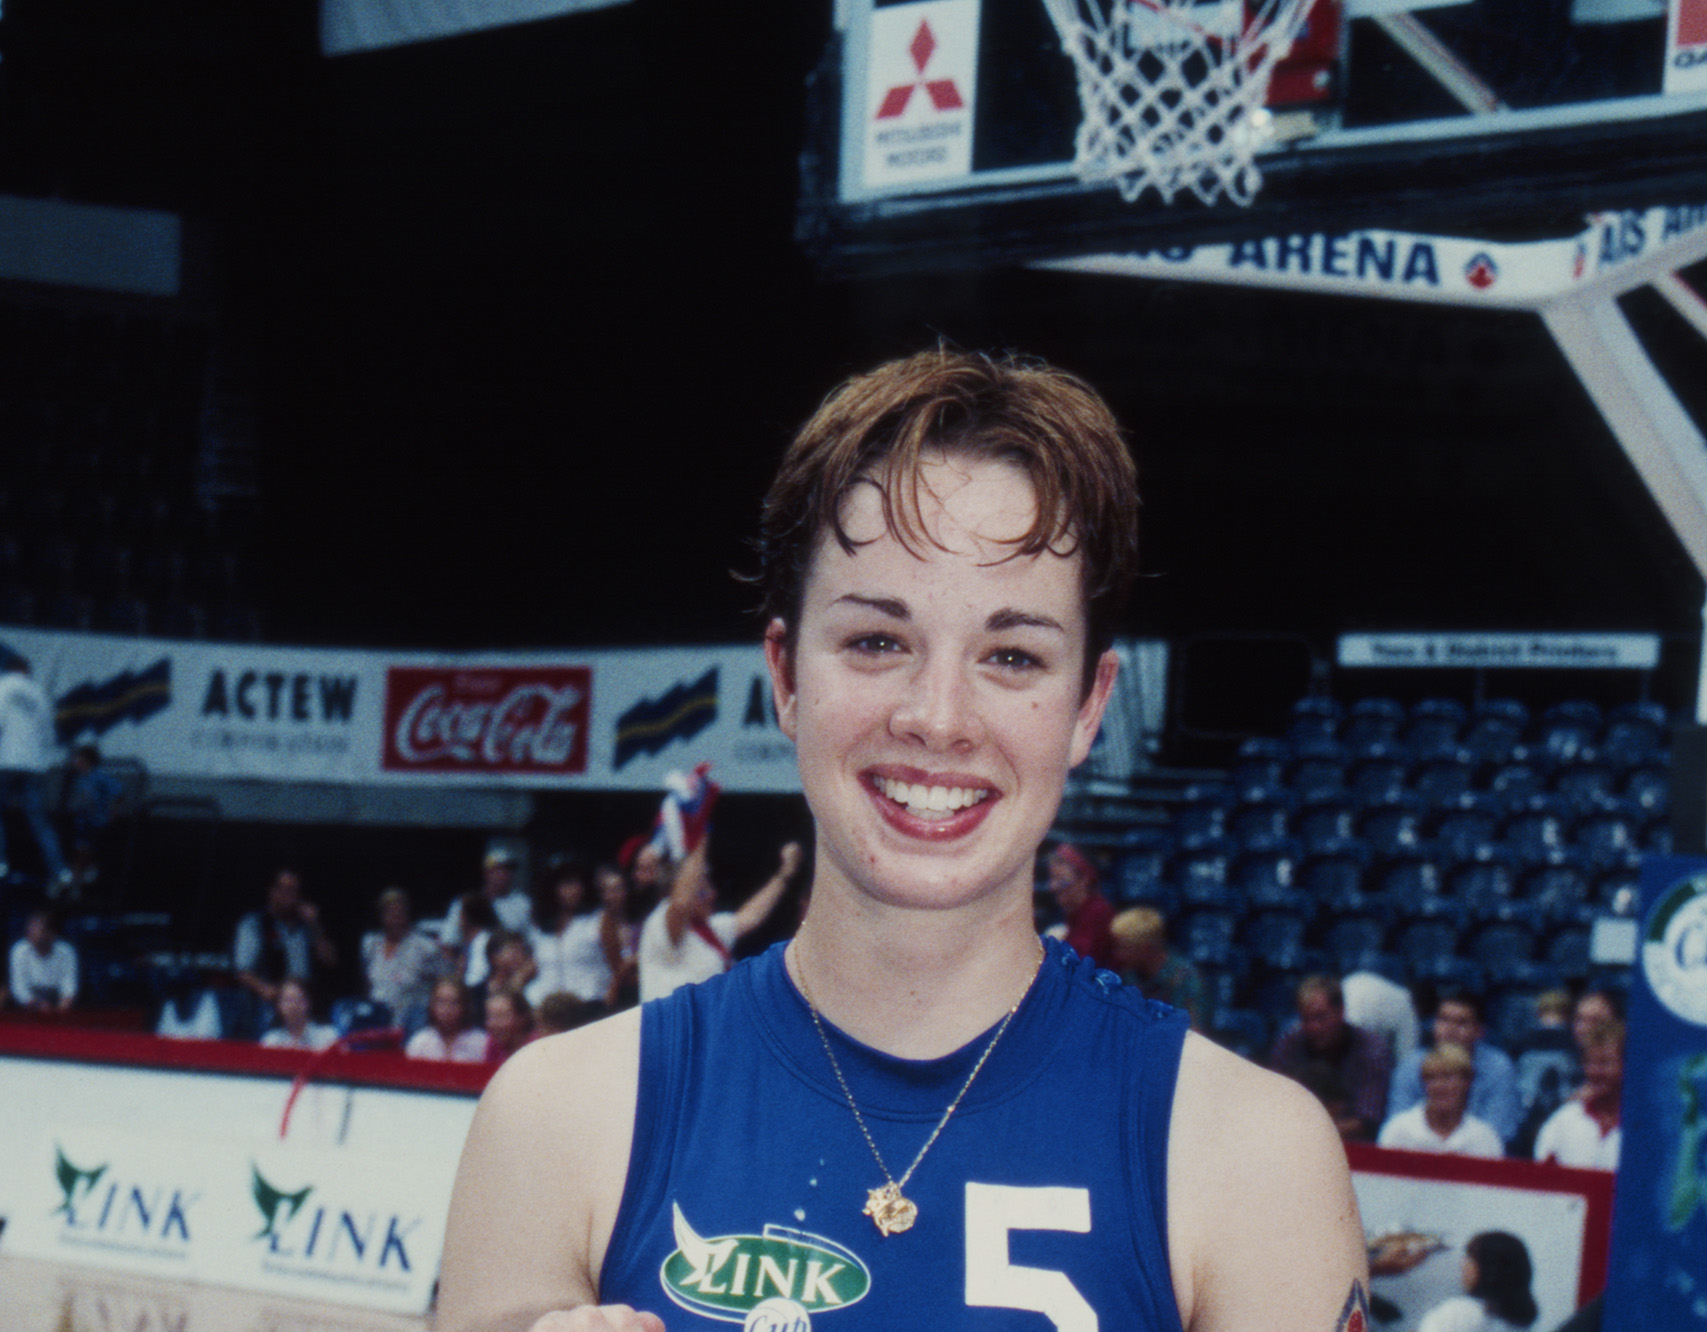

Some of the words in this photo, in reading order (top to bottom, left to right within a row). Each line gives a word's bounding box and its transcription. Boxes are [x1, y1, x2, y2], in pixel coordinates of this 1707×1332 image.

[1229, 235, 1439, 286] ARENA
[202, 669, 358, 723] ACTEW
[264, 1206, 422, 1272] LINK
[697, 1252, 846, 1304] LINK
